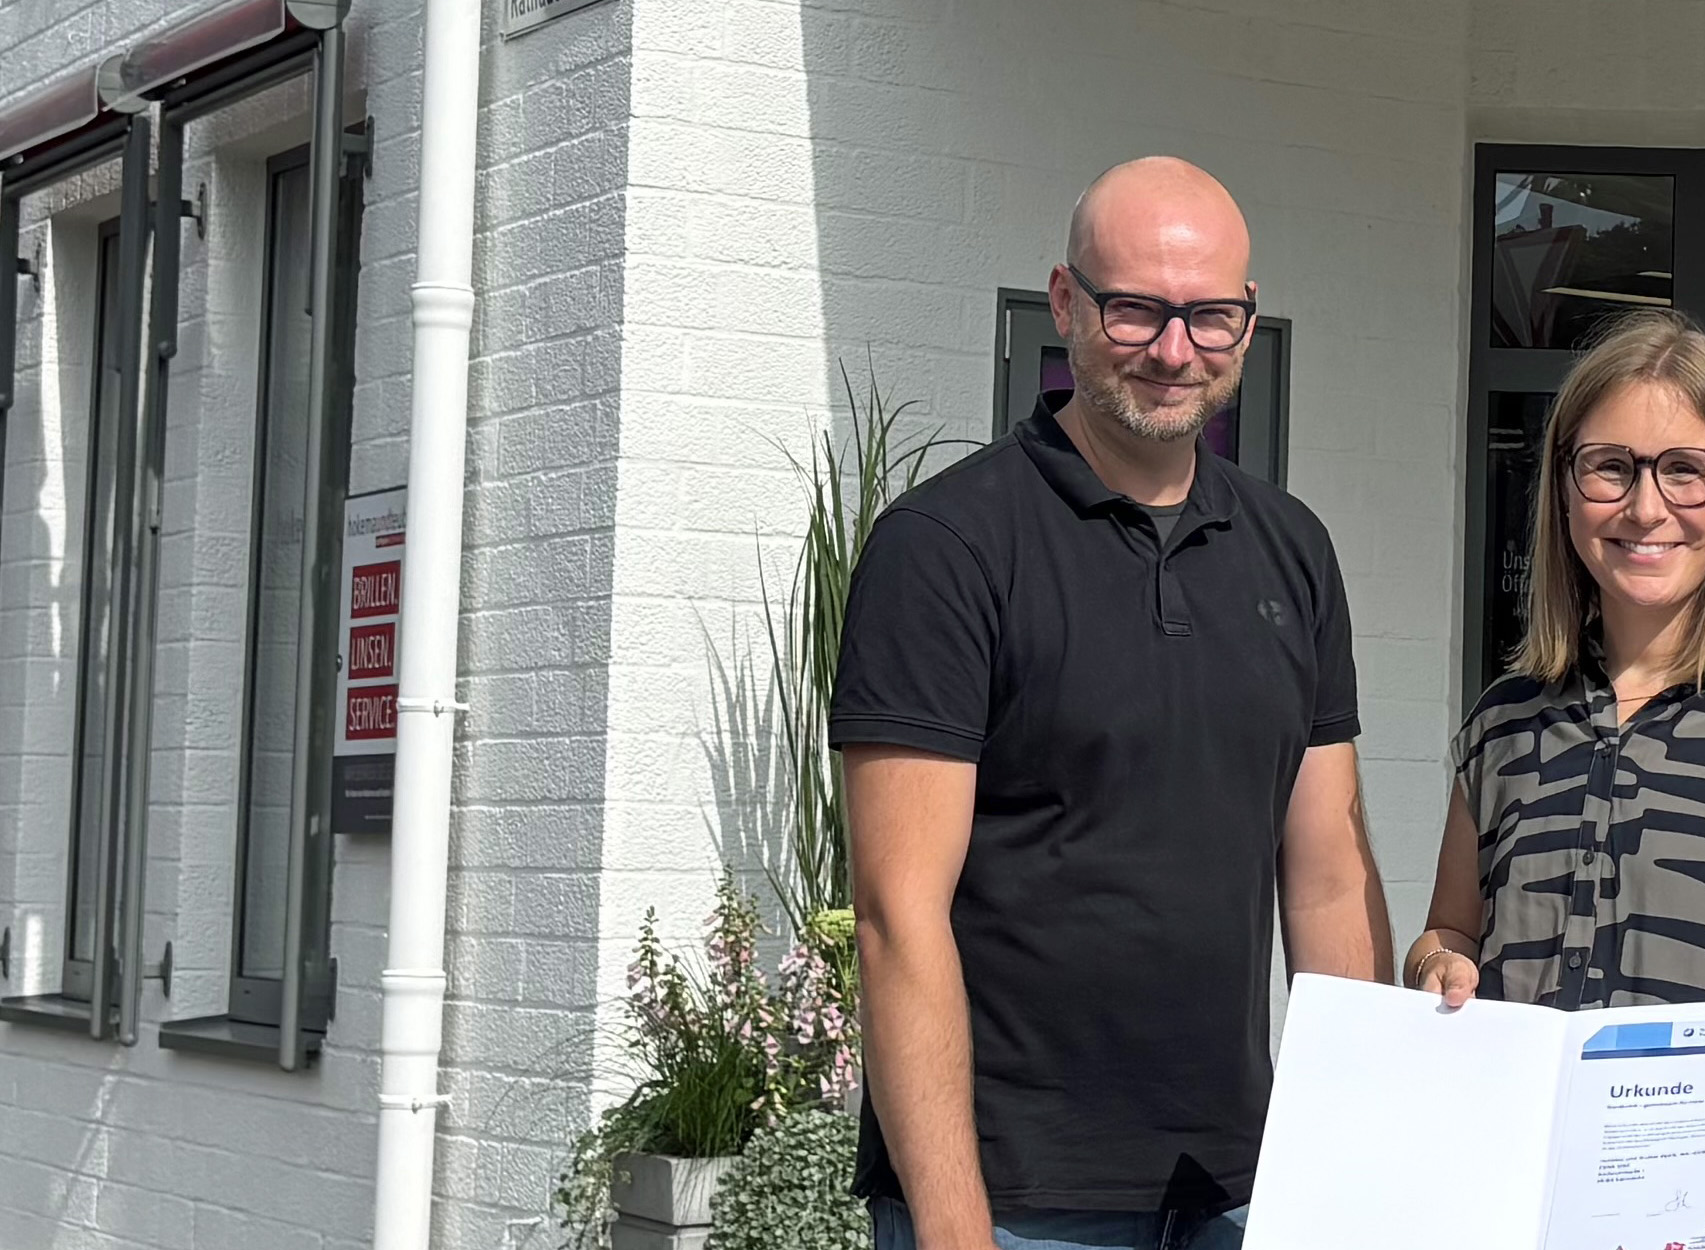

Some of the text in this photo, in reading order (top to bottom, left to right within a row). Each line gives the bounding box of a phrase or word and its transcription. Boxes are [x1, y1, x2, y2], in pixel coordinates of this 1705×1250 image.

[353, 573, 398, 610] BRILLEN.
[351, 634, 392, 670] LINSEN.
[1610, 1082, 1694, 1098] Urkunde
